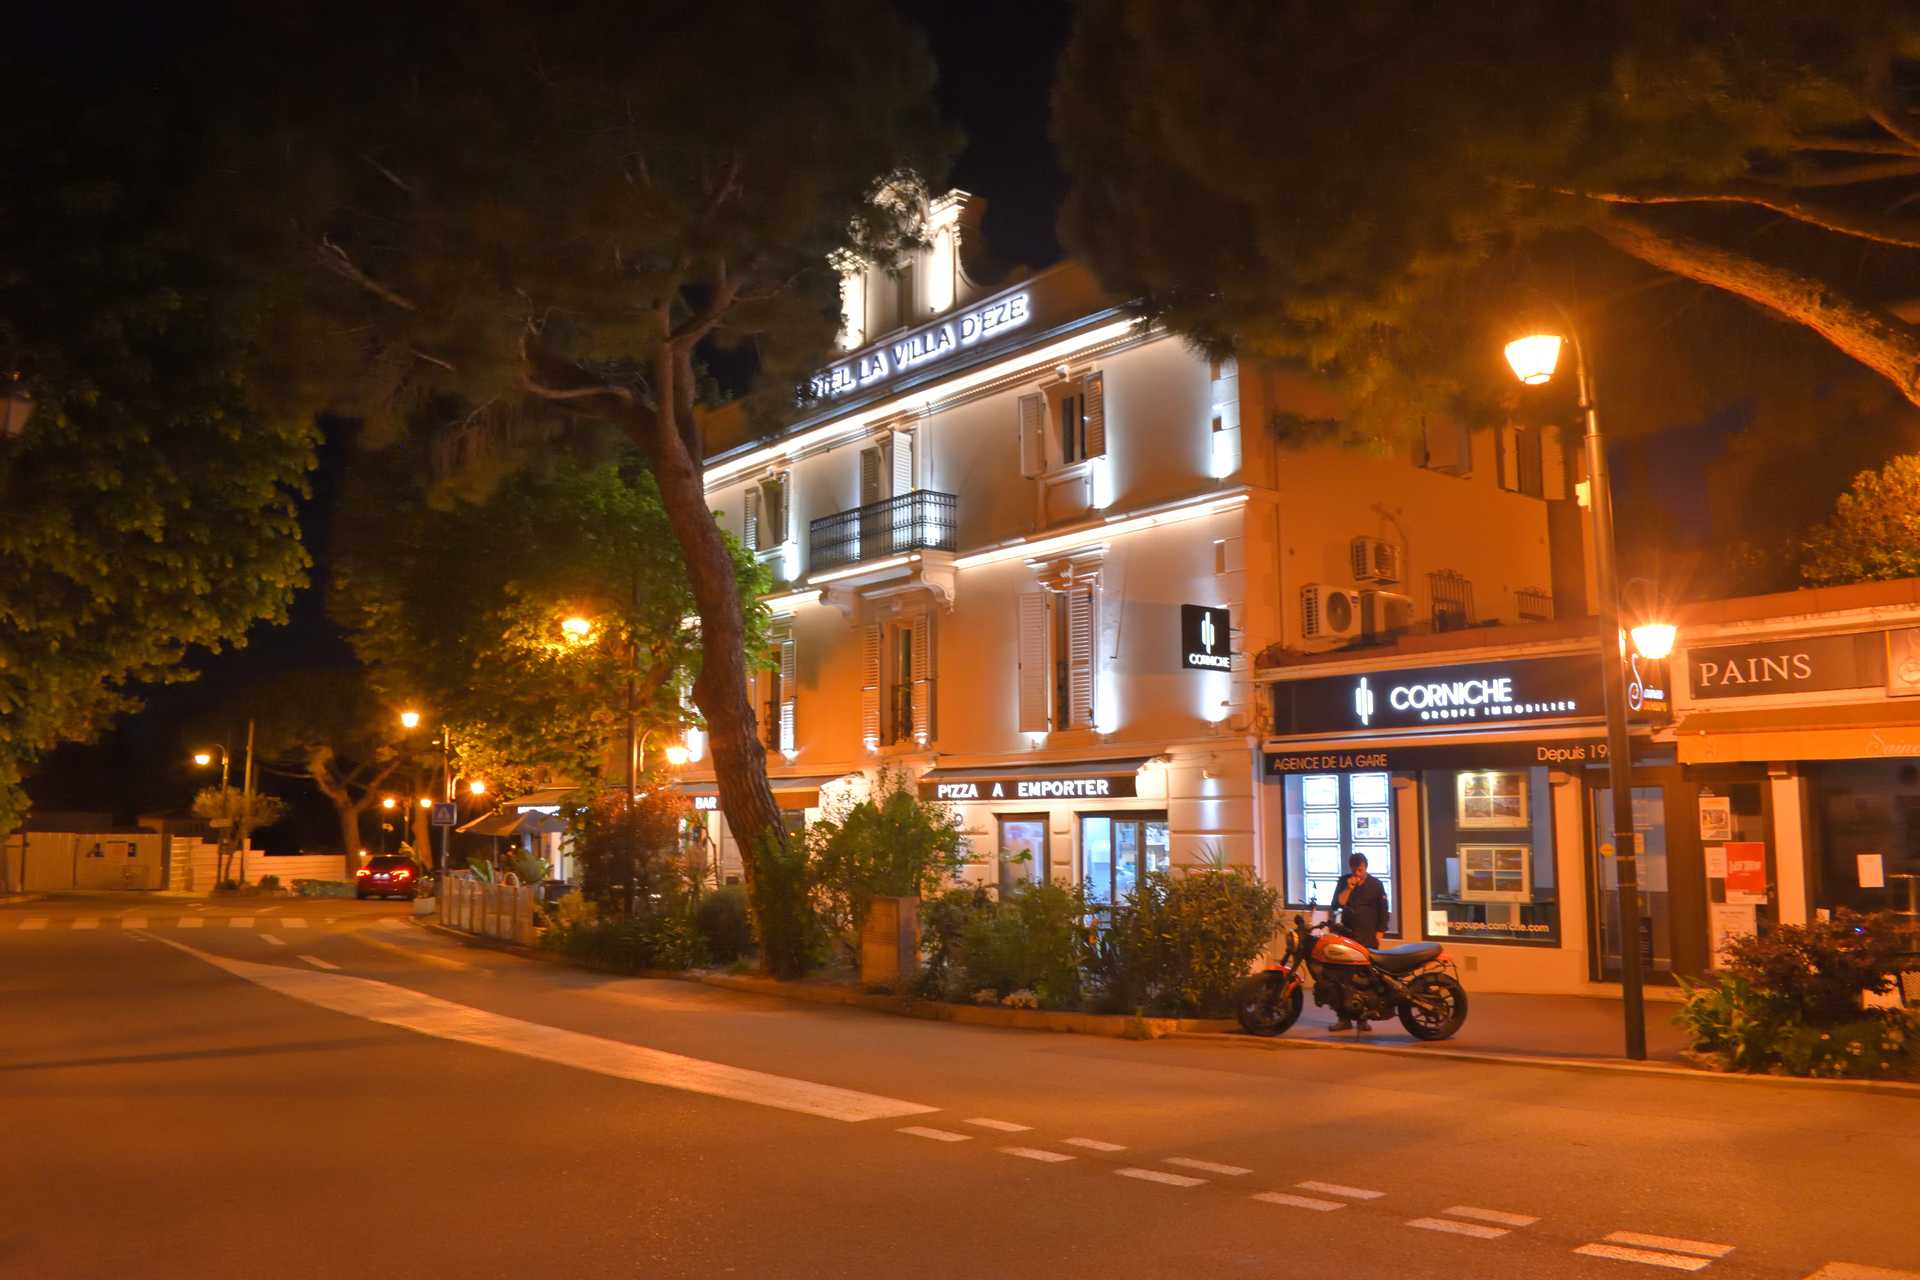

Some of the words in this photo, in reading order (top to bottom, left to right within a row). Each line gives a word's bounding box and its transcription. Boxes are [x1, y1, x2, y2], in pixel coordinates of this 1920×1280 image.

[859, 355, 884, 380] LA
[892, 327, 951, 366] VILLA
[960, 295, 1026, 339] D'EZE
[1698, 653, 1812, 687] PAINS
[1389, 677, 1513, 711] CORNICHE
[1420, 708, 1476, 720] GROUPE
[1484, 700, 1577, 716] IMMOBILIER
[1273, 756, 1319, 770] AGENCE
[1321, 755, 1337, 769] DE
[1339, 754, 1353, 769] LA
[1355, 753, 1388, 768] GARE
[1537, 745, 1585, 763] Depuis
[1590, 744, 1610, 759] 19
[937, 783, 979, 799] PIZZA
[991, 782, 1004, 798] A
[1017, 779, 1109, 798] EMPORTER
[695, 796, 717, 810] BAR
